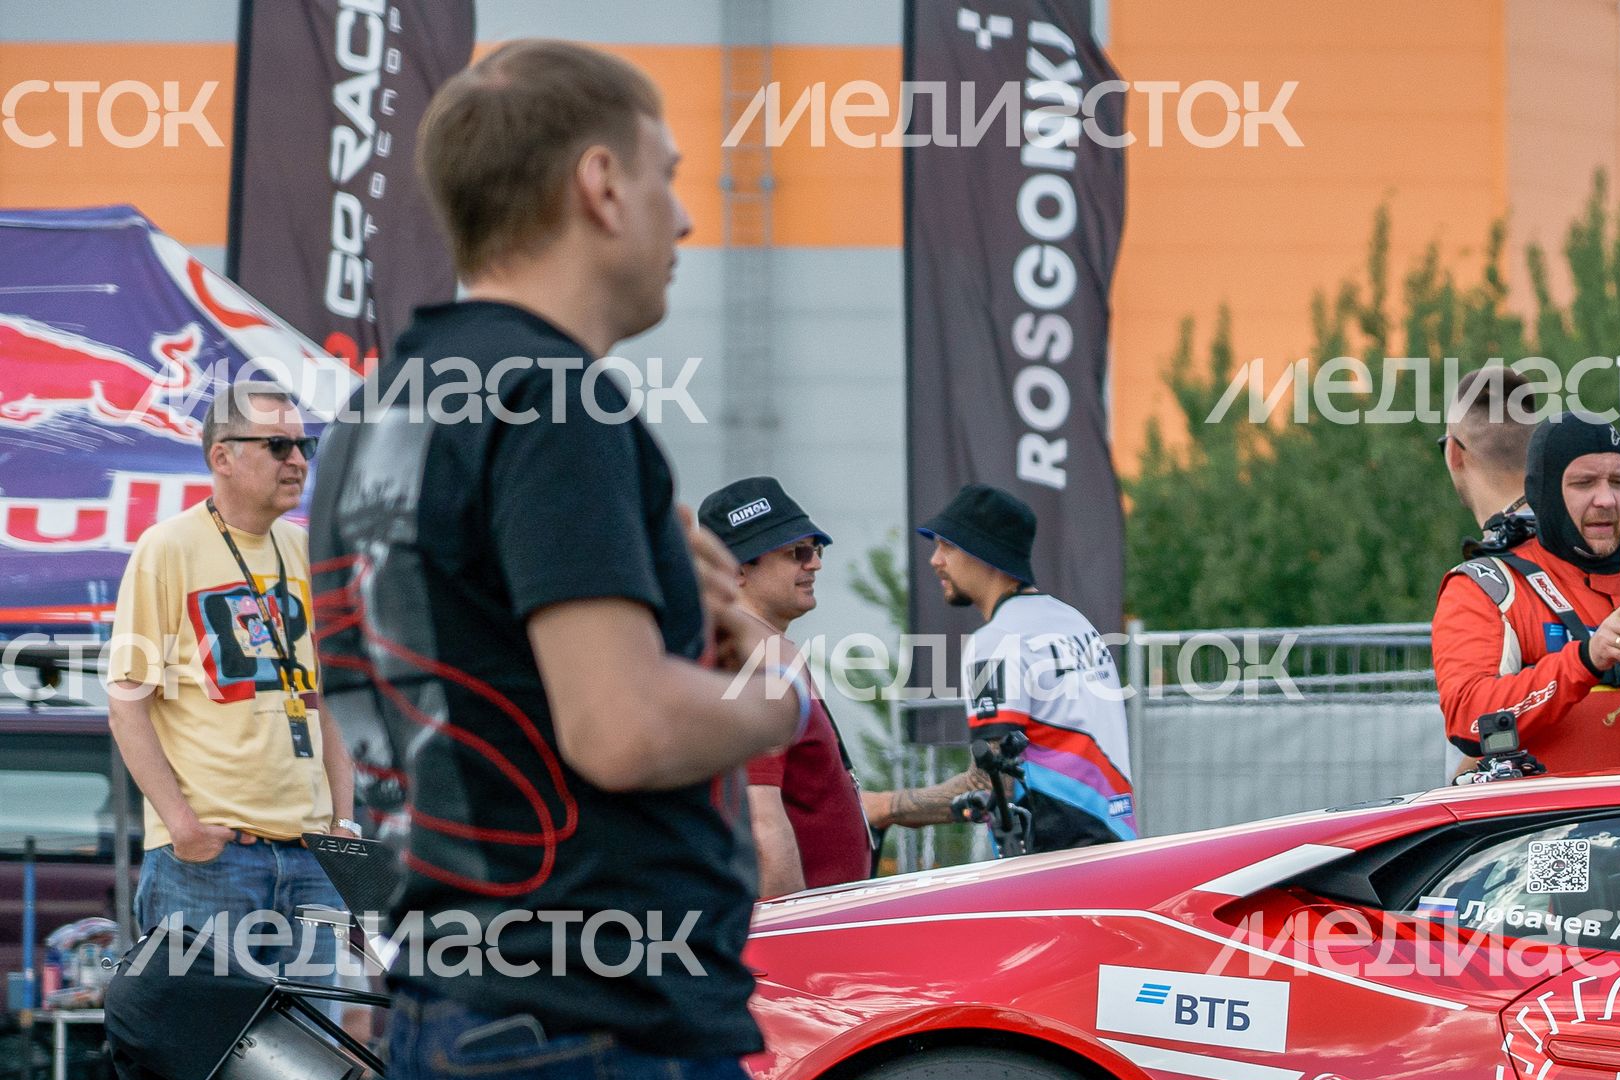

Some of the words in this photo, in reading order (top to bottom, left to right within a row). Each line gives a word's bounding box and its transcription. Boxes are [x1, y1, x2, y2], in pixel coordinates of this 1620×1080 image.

[731, 501, 768, 523] AIMOL
[1459, 900, 1601, 937] Лобачев
[1175, 994, 1250, 1031] ВТБ
